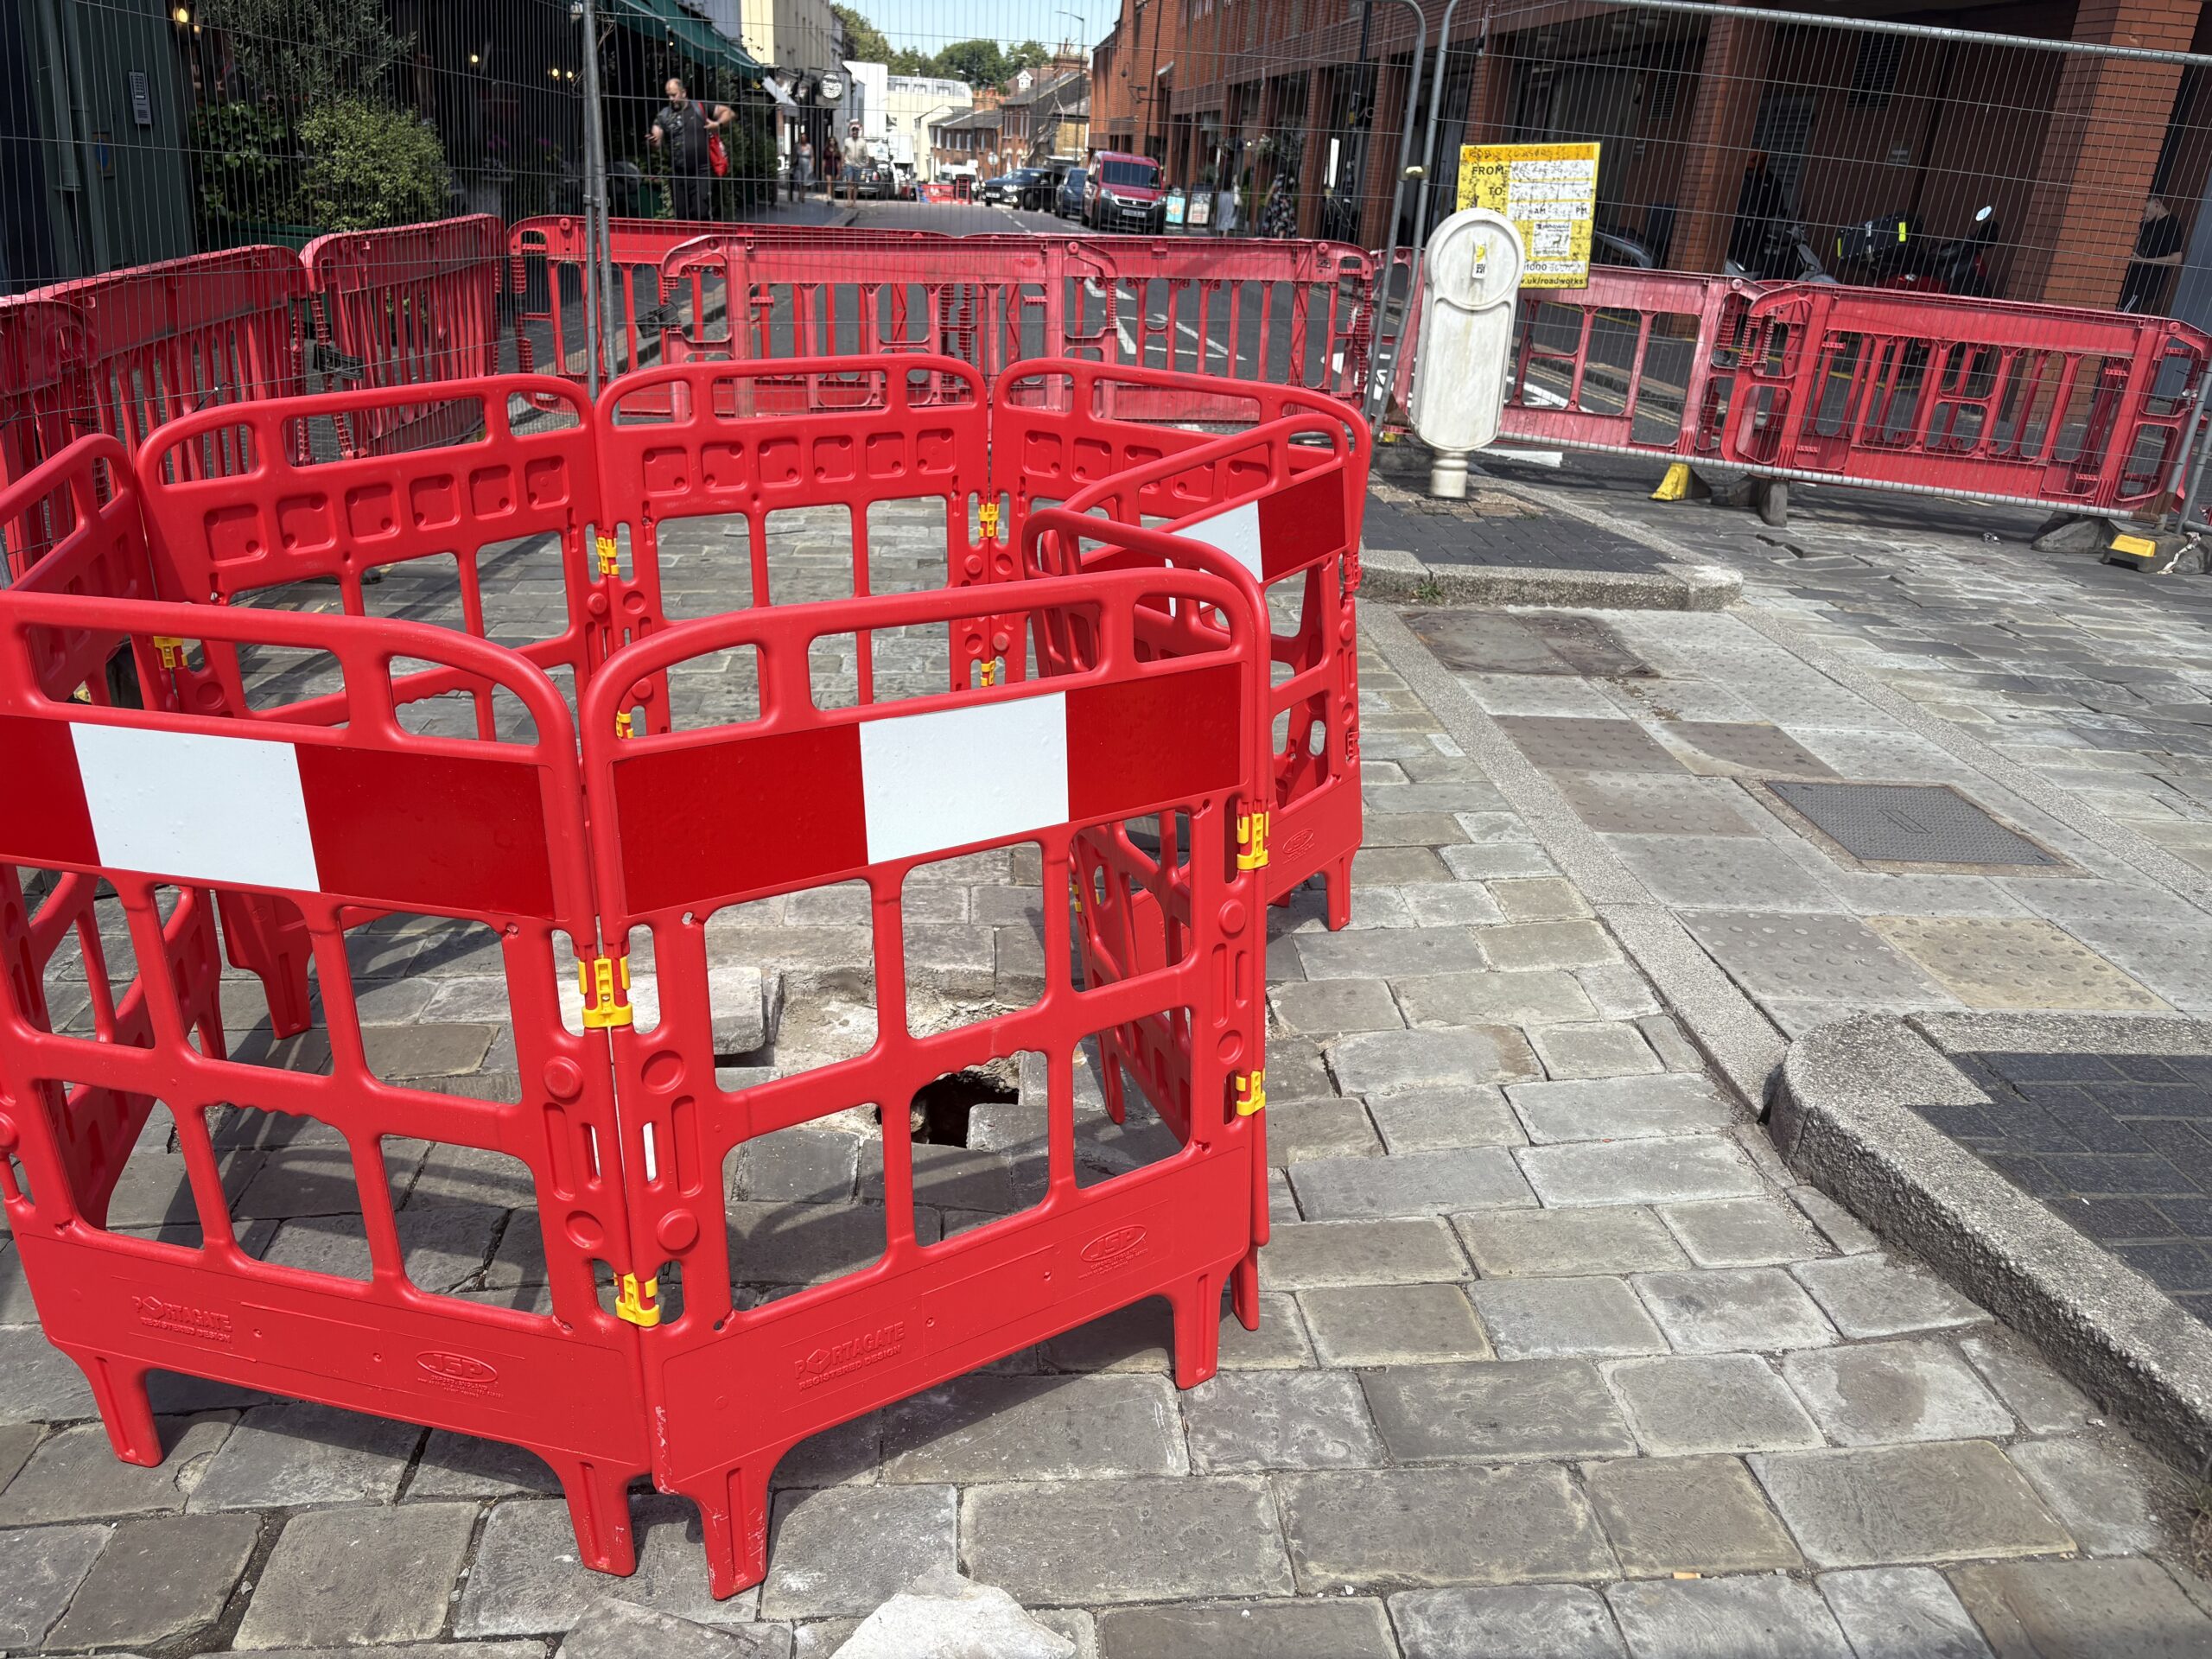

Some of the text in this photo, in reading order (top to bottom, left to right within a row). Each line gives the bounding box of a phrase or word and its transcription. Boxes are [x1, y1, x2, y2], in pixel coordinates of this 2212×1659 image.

[1090, 1226, 1135, 1260] JSP
[429, 1353, 484, 1379] JSP
[798, 1344, 902, 1391] REGISTERED DESIGN
